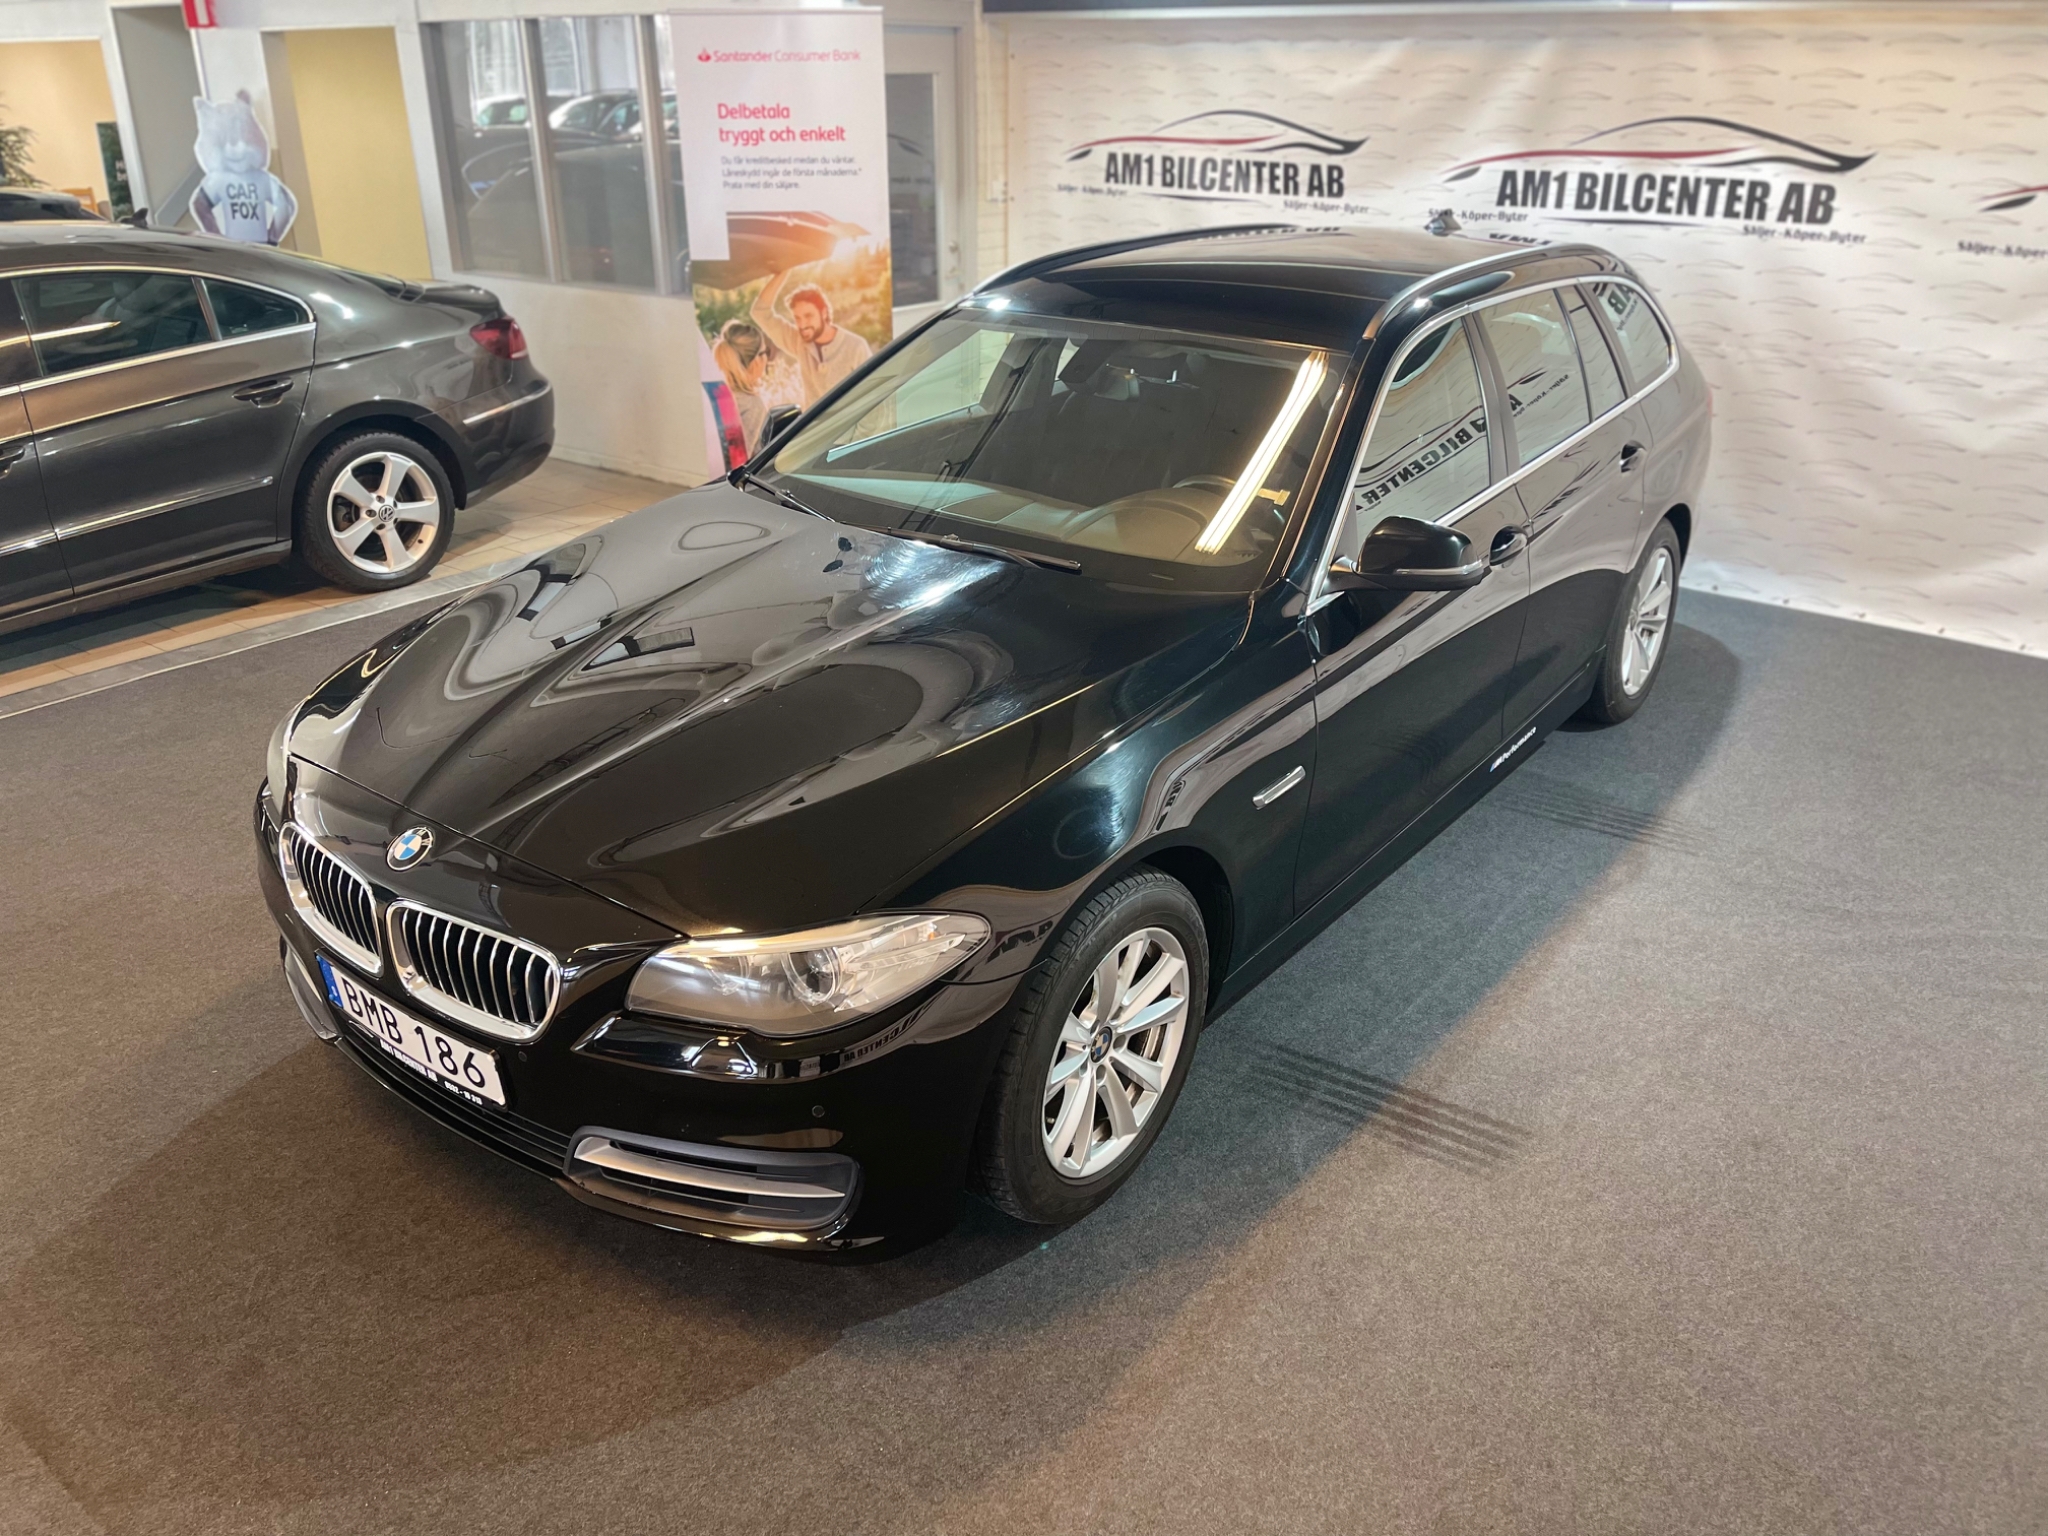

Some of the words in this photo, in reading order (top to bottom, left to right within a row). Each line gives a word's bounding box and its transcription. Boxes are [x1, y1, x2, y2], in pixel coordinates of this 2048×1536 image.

[713, 50, 773, 63] Santander
[774, 50, 831, 62] Consumer
[832, 49, 861, 61] Bank
[717, 103, 791, 119] Delbetala
[719, 127, 765, 146] tryggt
[769, 126, 796, 141] och
[800, 126, 846, 141] enkelt
[1104, 150, 1155, 187] AM1
[1161, 154, 1300, 197] BILCENTER
[1306, 163, 1345, 199] AB
[226, 183, 259, 200] CAR
[1495, 169, 1567, 211] AM1
[1573, 171, 1773, 223] BILCENTER
[1776, 182, 1838, 226] AB
[230, 202, 260, 221] FOX
[341, 975, 403, 1045] BMB
[414, 1025, 486, 1088] 186
